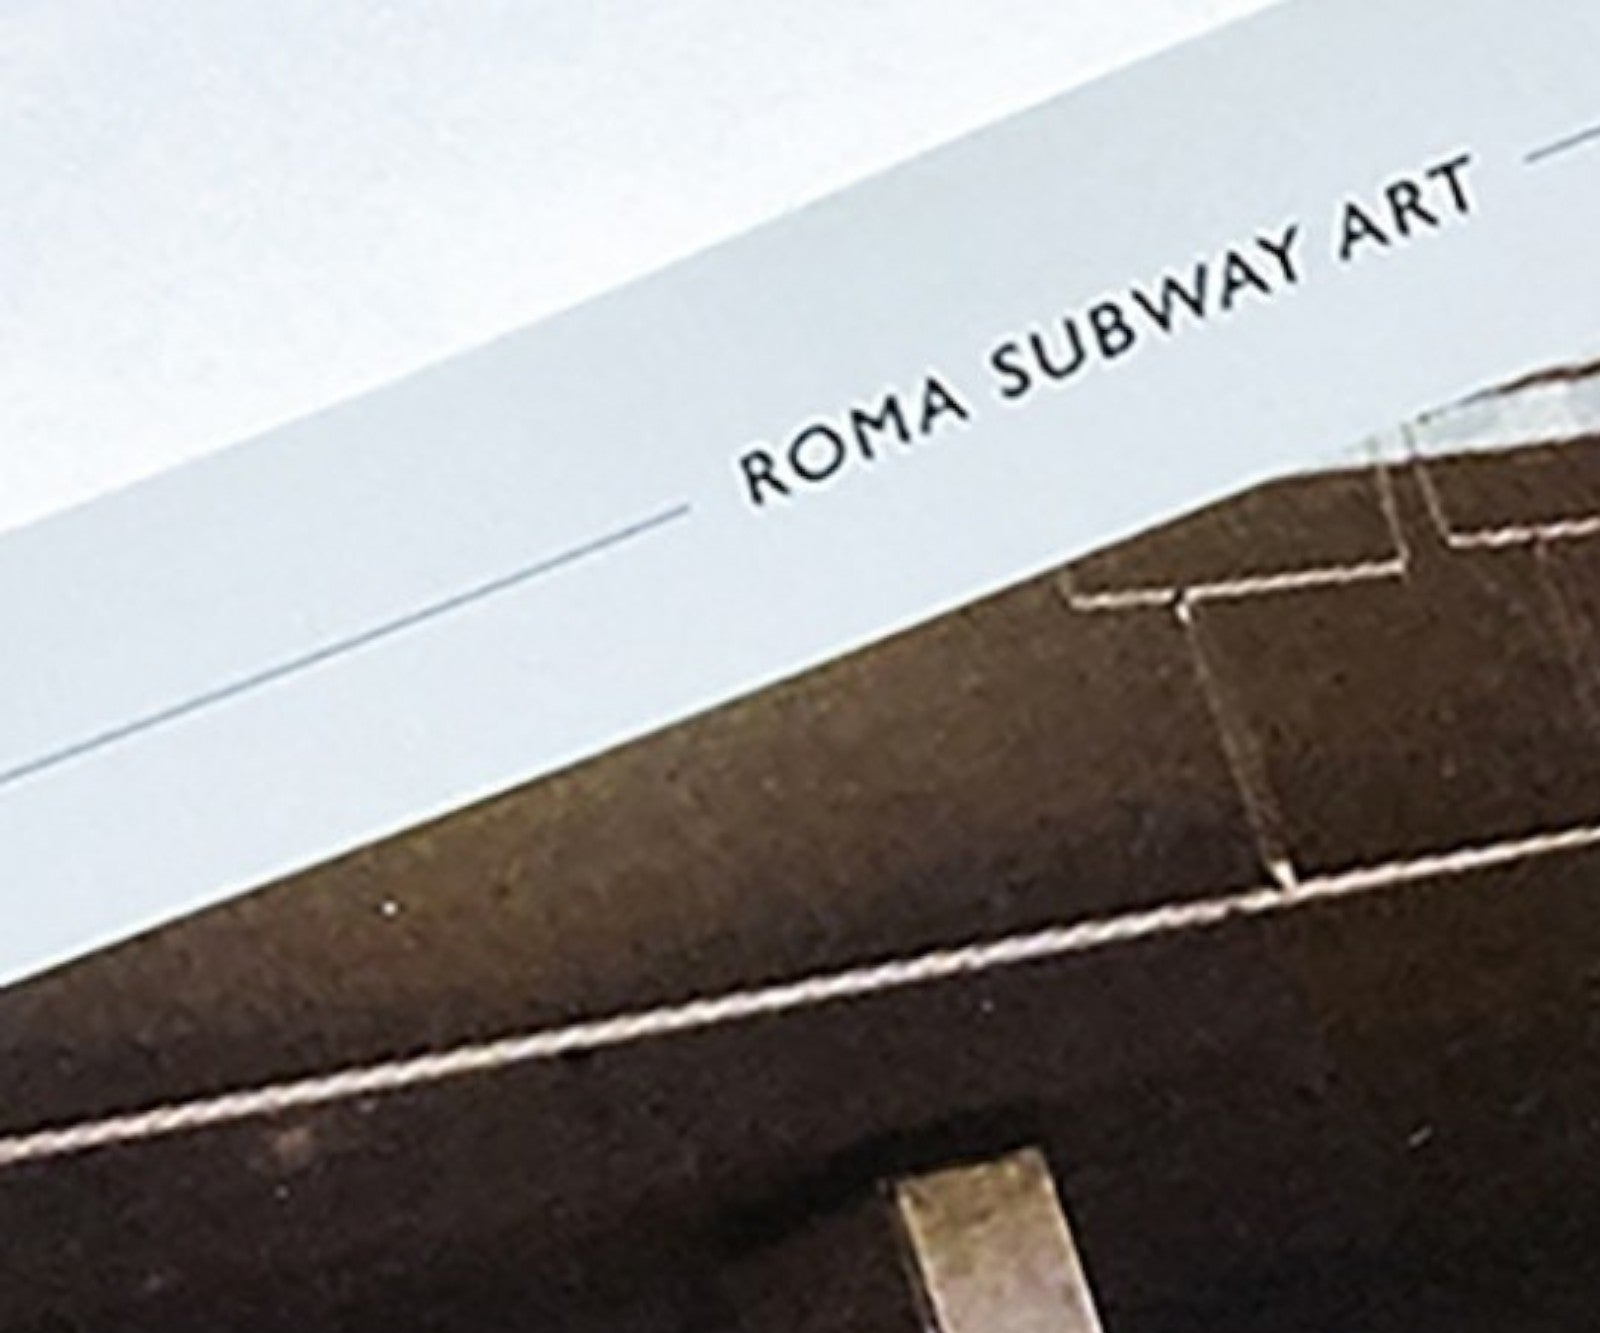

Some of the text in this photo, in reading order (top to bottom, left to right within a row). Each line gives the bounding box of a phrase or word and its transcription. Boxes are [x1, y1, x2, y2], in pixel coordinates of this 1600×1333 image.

[738, 154, 1474, 507] ROMA SUBWAY ART
